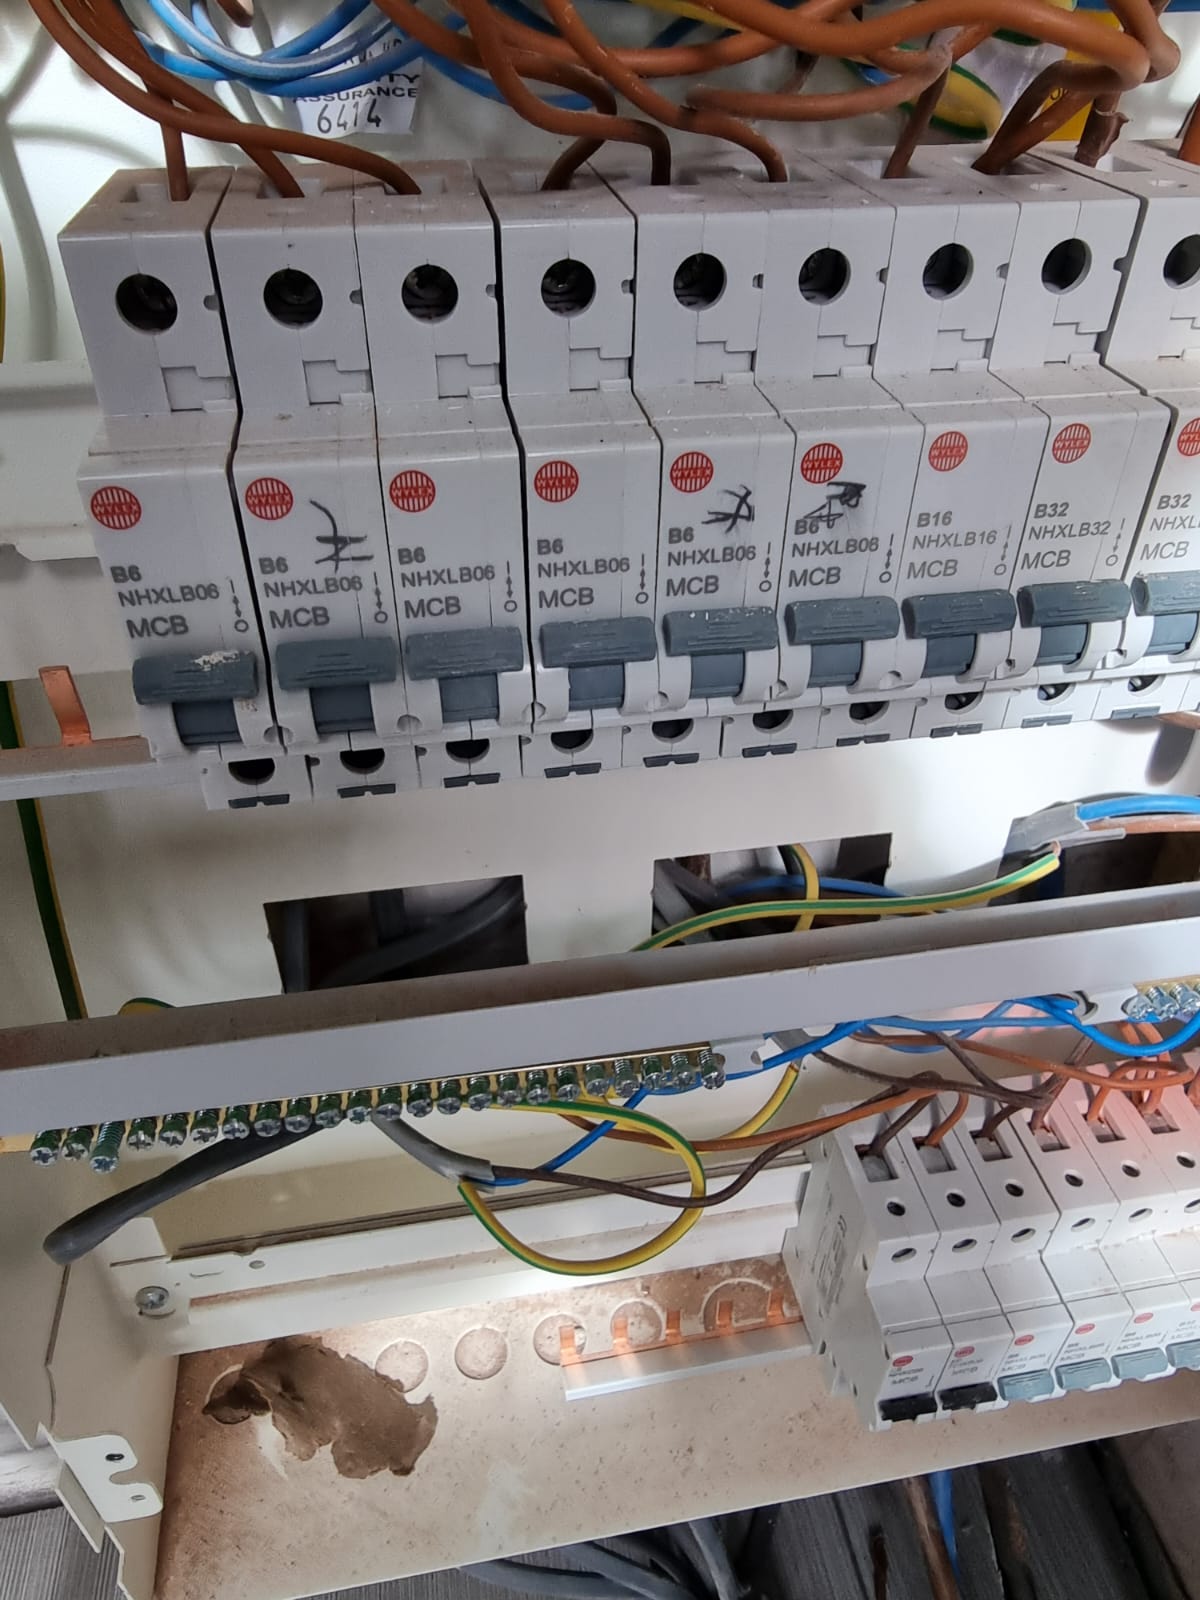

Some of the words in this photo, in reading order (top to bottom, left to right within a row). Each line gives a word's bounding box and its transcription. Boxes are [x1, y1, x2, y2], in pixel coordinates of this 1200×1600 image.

[317, 98, 381, 134] 6414
[931, 446, 966, 457] WYLEX
[1055, 438, 1090, 450] WYLEX
[672, 468, 712, 479] WYLEX
[803, 459, 841, 470] WYLEX
[391, 487, 435, 498] WYLEX
[536, 478, 577, 488] WYLEX
[94, 503, 139, 515] WYLEX
[247, 494, 292, 506] WYLEX
[1157, 494, 1191, 510] B32
[917, 511, 952, 527] B16
[1034, 502, 1069, 519] B32
[794, 519, 820, 535] B6
[1028, 521, 1111, 541] NHXLB32
[1149, 516, 1200, 532] NHXL
[668, 527, 694, 544] B6
[912, 530, 997, 550] NHXLB16
[398, 547, 426, 565] B6
[537, 538, 564, 555] B6
[1140, 541, 1189, 560] MCB
[258, 556, 288, 575] B6
[668, 546, 756, 567] NHXLB06
[1021, 549, 1071, 571] MCB
[110, 565, 142, 583] B6
[401, 565, 495, 588] NHXLB06
[538, 557, 630, 578] NHXLB06
[788, 566, 841, 588] MCB
[907, 559, 958, 580] MCB
[118, 583, 220, 607] NHXLB06
[263, 576, 363, 598] NHXLB06
[666, 575, 719, 597] MCB
[404, 596, 462, 619] MCB
[538, 587, 595, 609] MCB
[126, 615, 189, 639] MCB
[269, 606, 330, 629] MCB
